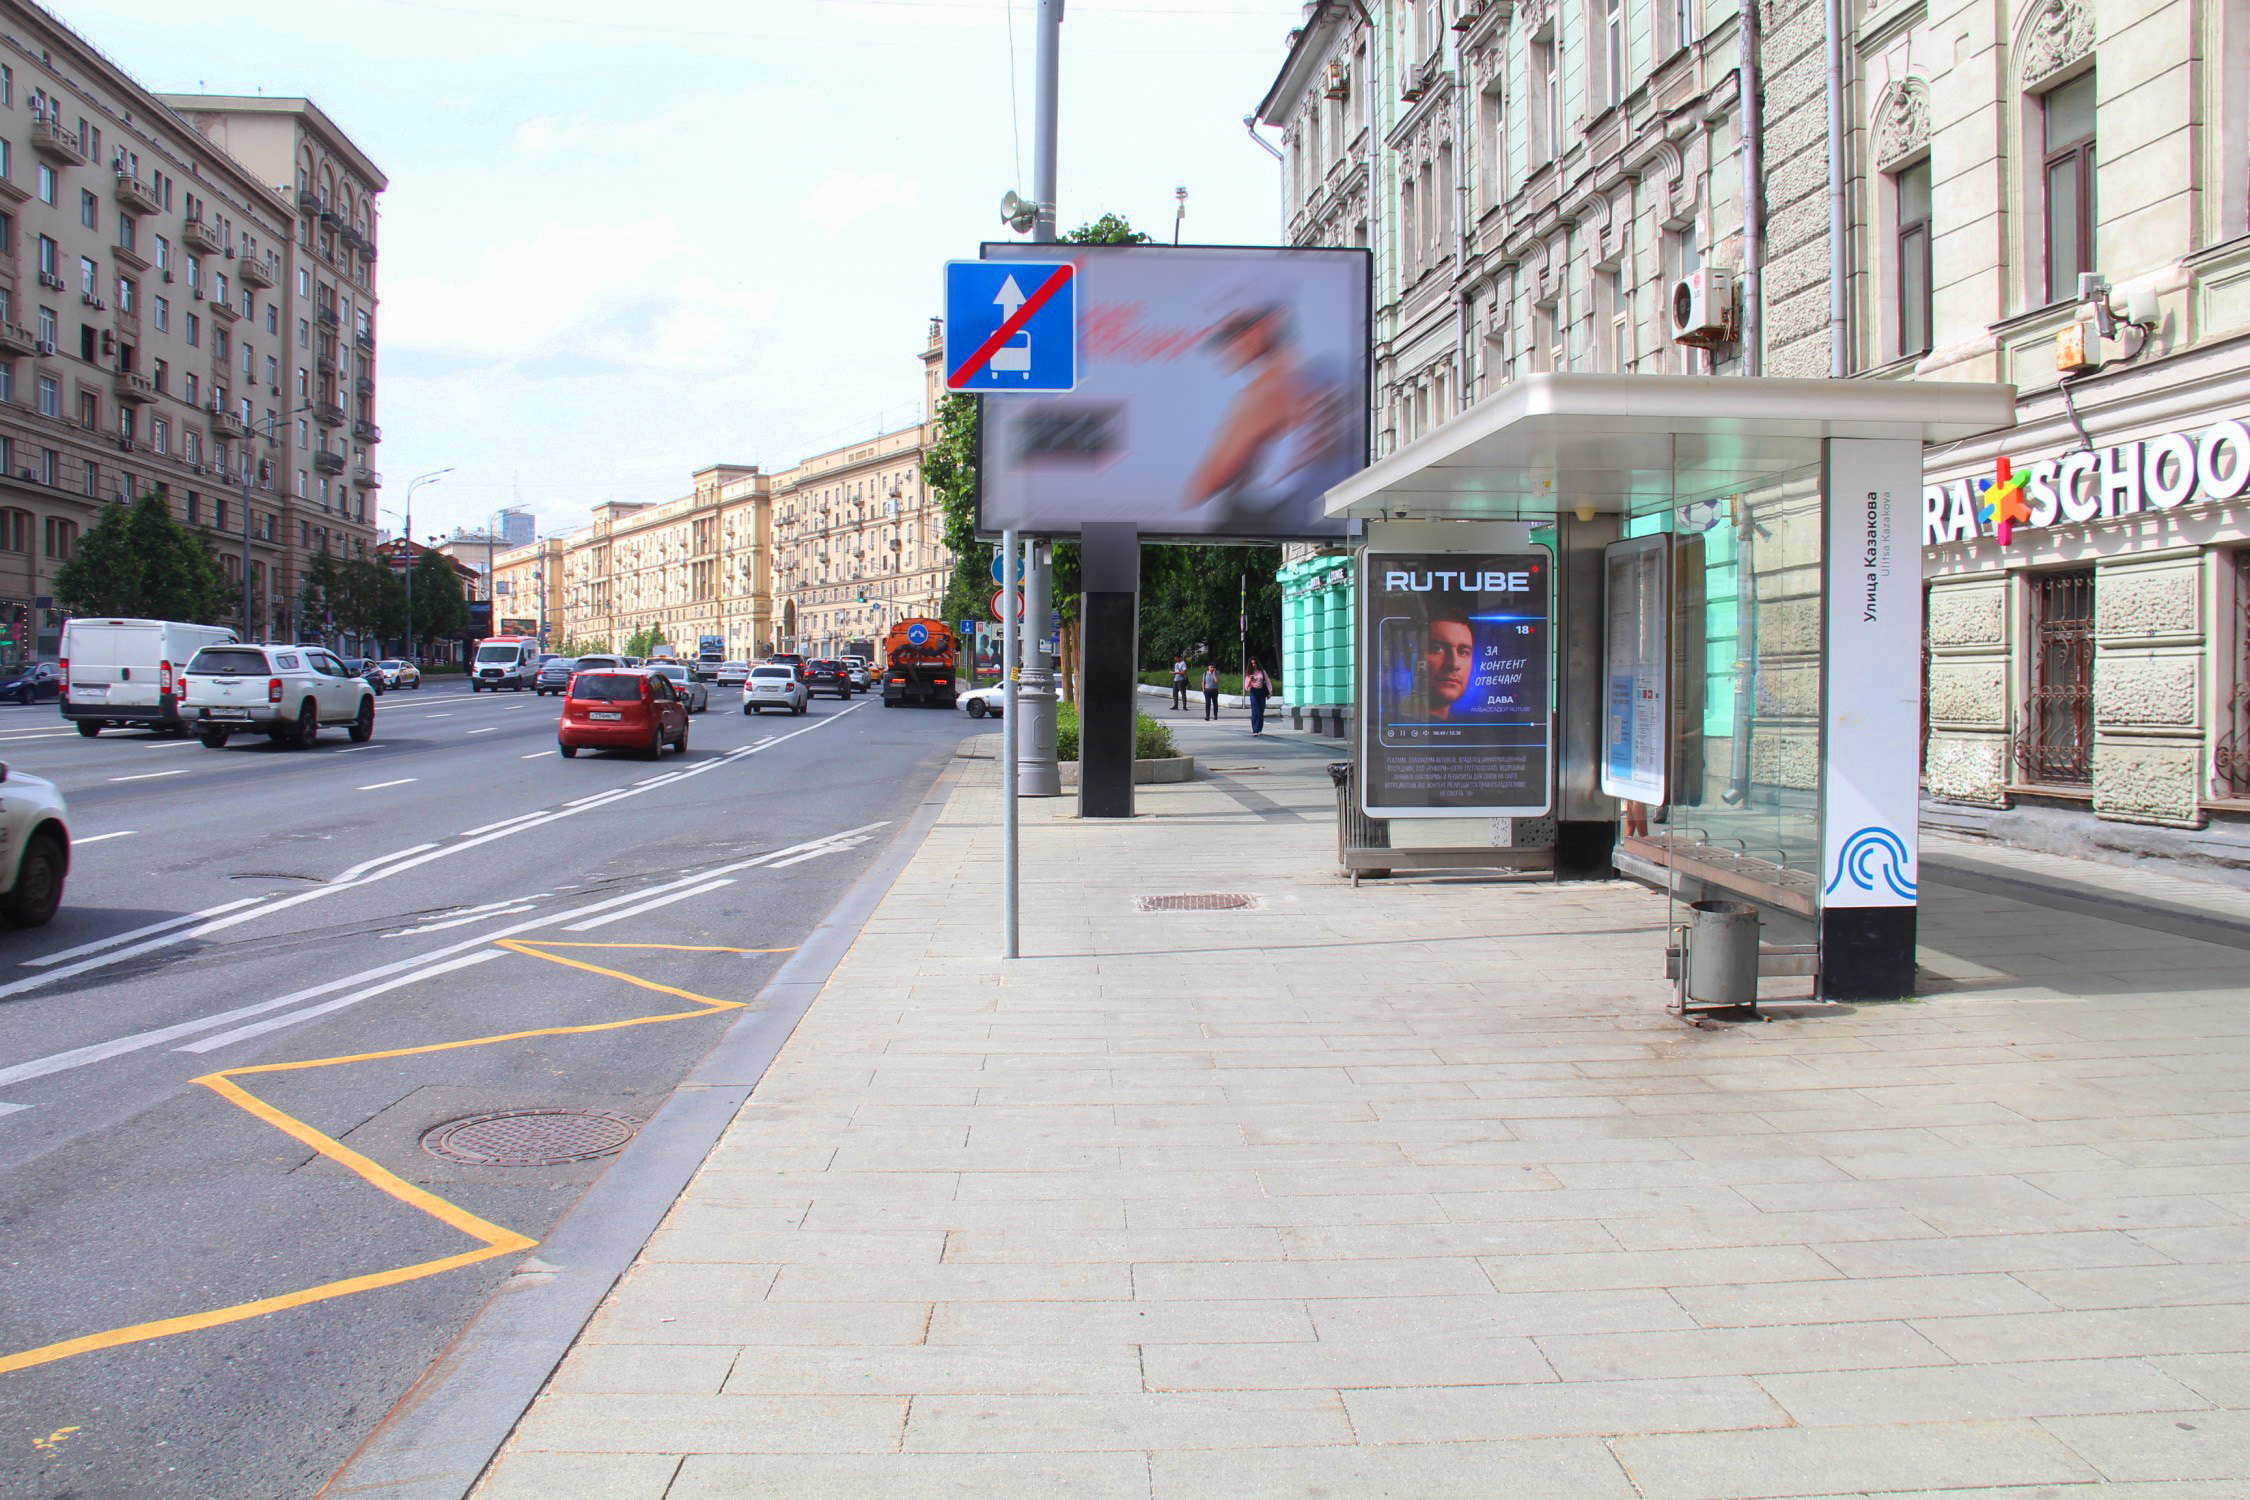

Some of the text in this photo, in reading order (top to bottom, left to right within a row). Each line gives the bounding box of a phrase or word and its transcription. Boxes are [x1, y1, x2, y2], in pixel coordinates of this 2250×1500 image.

[1881, 491, 1891, 577] Ulitsa Kazakova
[1863, 491, 1879, 622] Улица Казакова
[1386, 571, 1530, 592] RUTUBE
[1484, 645, 1499, 657] ЗА
[1479, 658, 1527, 672] КОНТЕНТ
[1474, 673, 1522, 687] ОТВЕЧАЮ!
[1487, 695, 1514, 705] ДАВА
